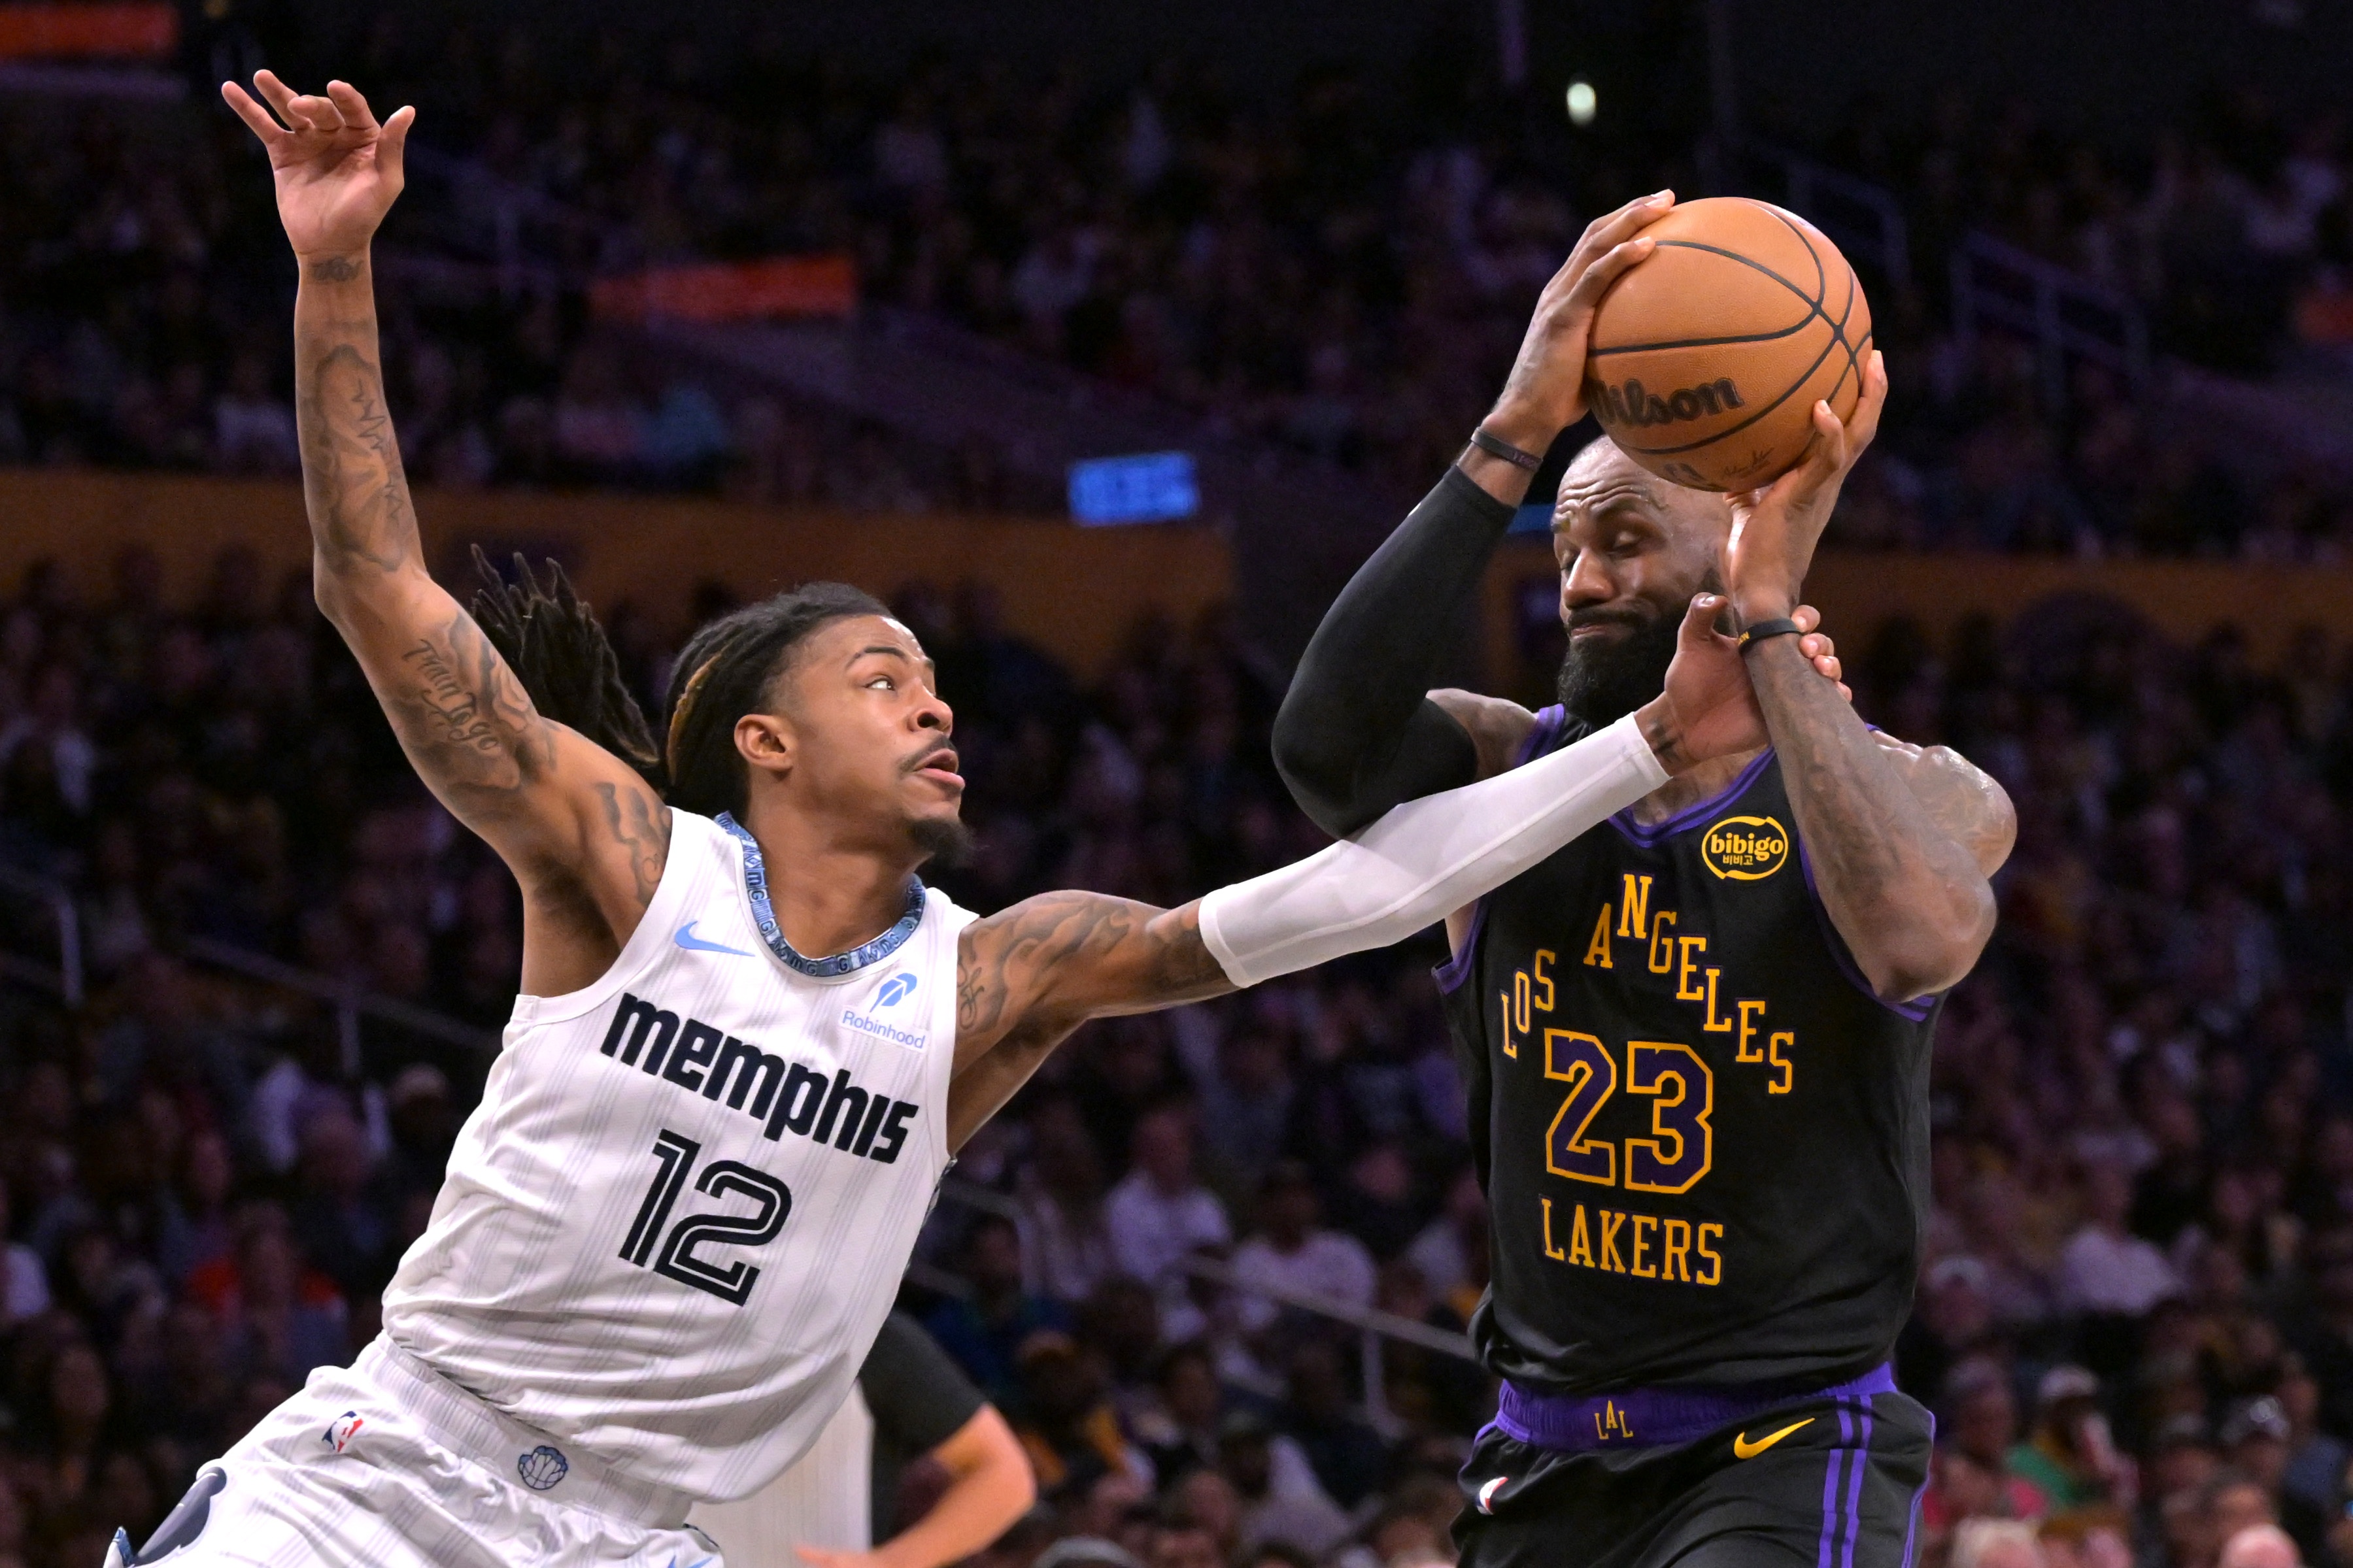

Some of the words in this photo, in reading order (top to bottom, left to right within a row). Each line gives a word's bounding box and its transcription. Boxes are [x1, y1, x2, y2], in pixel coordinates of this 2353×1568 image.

[1711, 832, 1784, 861] bibigo
[1722, 854, 1753, 865] 비비고
[1501, 950, 1555, 1059] LOS
[1584, 874, 1794, 1094] ANGELES
[842, 1010, 926, 1049] Robinhood
[1544, 1028, 1713, 1194] 23
[618, 1128, 792, 1307] 12
[1540, 1198, 1724, 1286] LAKERS
[1595, 1400, 1633, 1439] LAL
